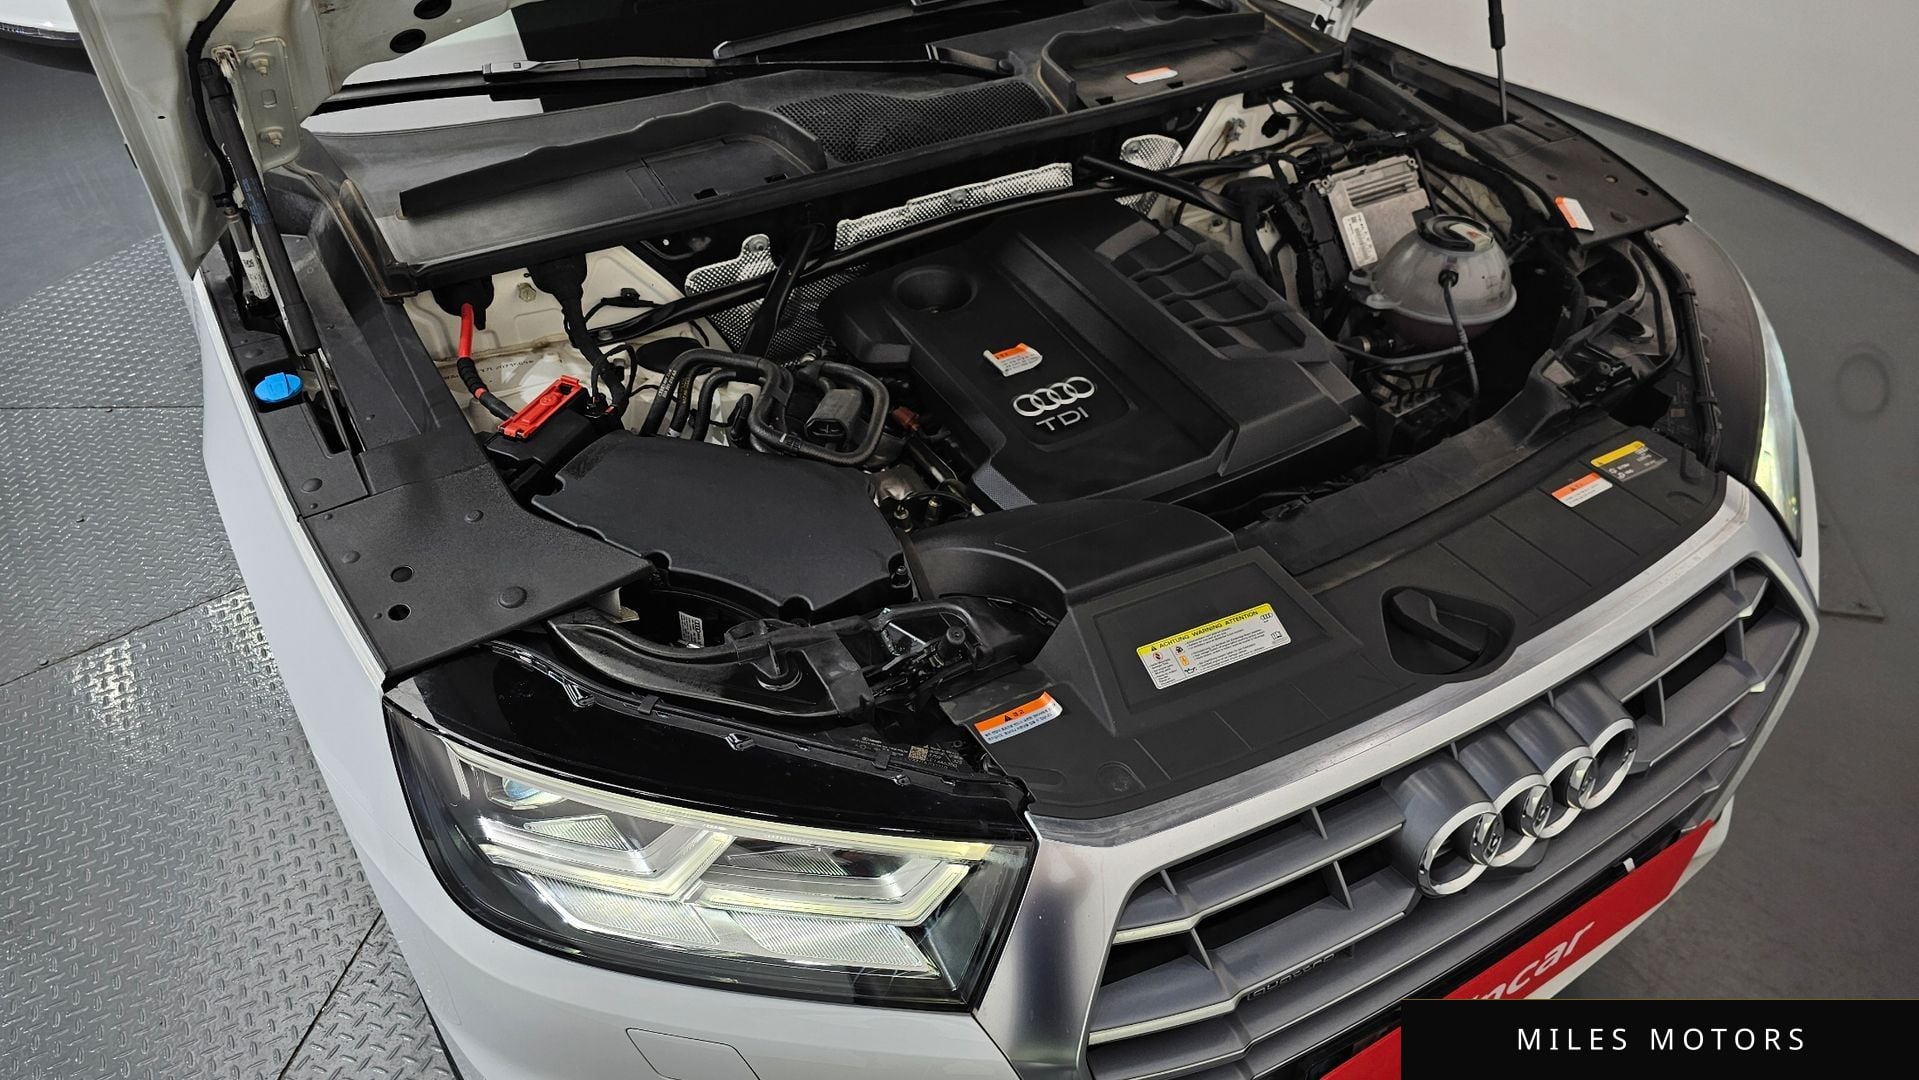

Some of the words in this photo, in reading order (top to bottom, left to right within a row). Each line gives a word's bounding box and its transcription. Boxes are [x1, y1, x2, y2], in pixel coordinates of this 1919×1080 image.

[1036, 407, 1089, 431] TDI
[1159, 634, 1190, 649] ACHTUNG
[1191, 622, 1223, 638] WARNING
[1225, 609, 1259, 626] ATTENTION
